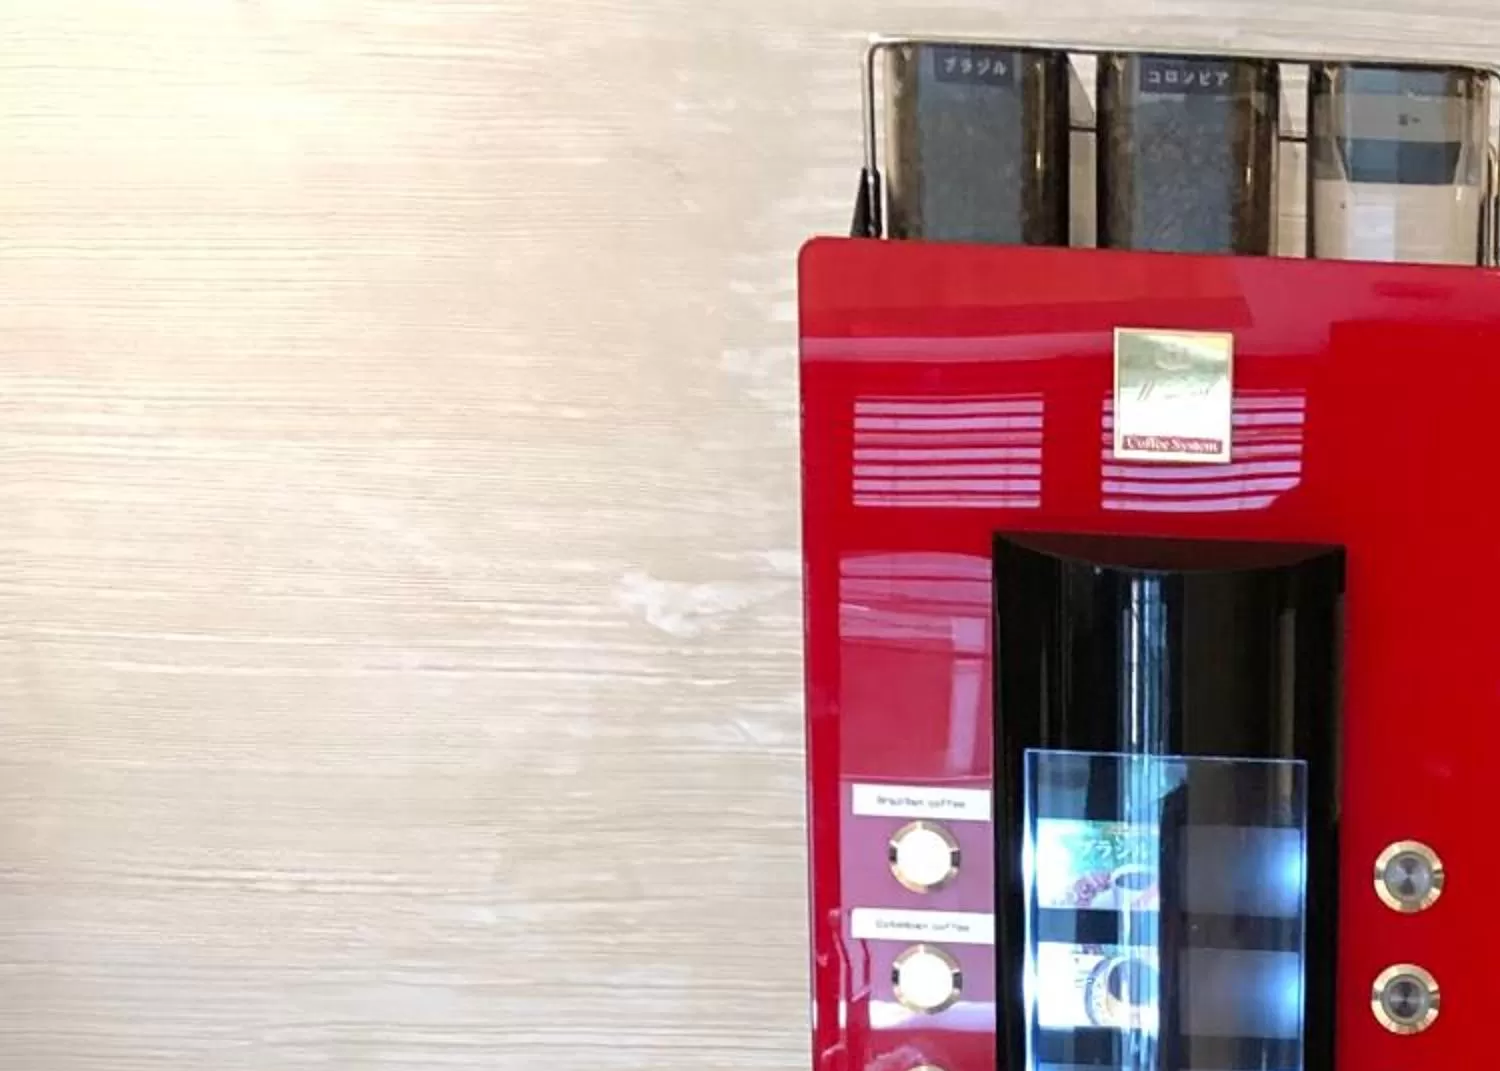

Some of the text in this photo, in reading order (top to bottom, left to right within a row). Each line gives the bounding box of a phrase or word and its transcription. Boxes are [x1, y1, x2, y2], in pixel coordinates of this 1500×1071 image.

[943, 56, 1009, 77] ブラジル
[1147, 69, 1230, 87] コロンビア
[1126, 436, 1218, 453] Coffee System
[927, 798, 966, 809] coffee
[931, 922, 970, 932] coffee
